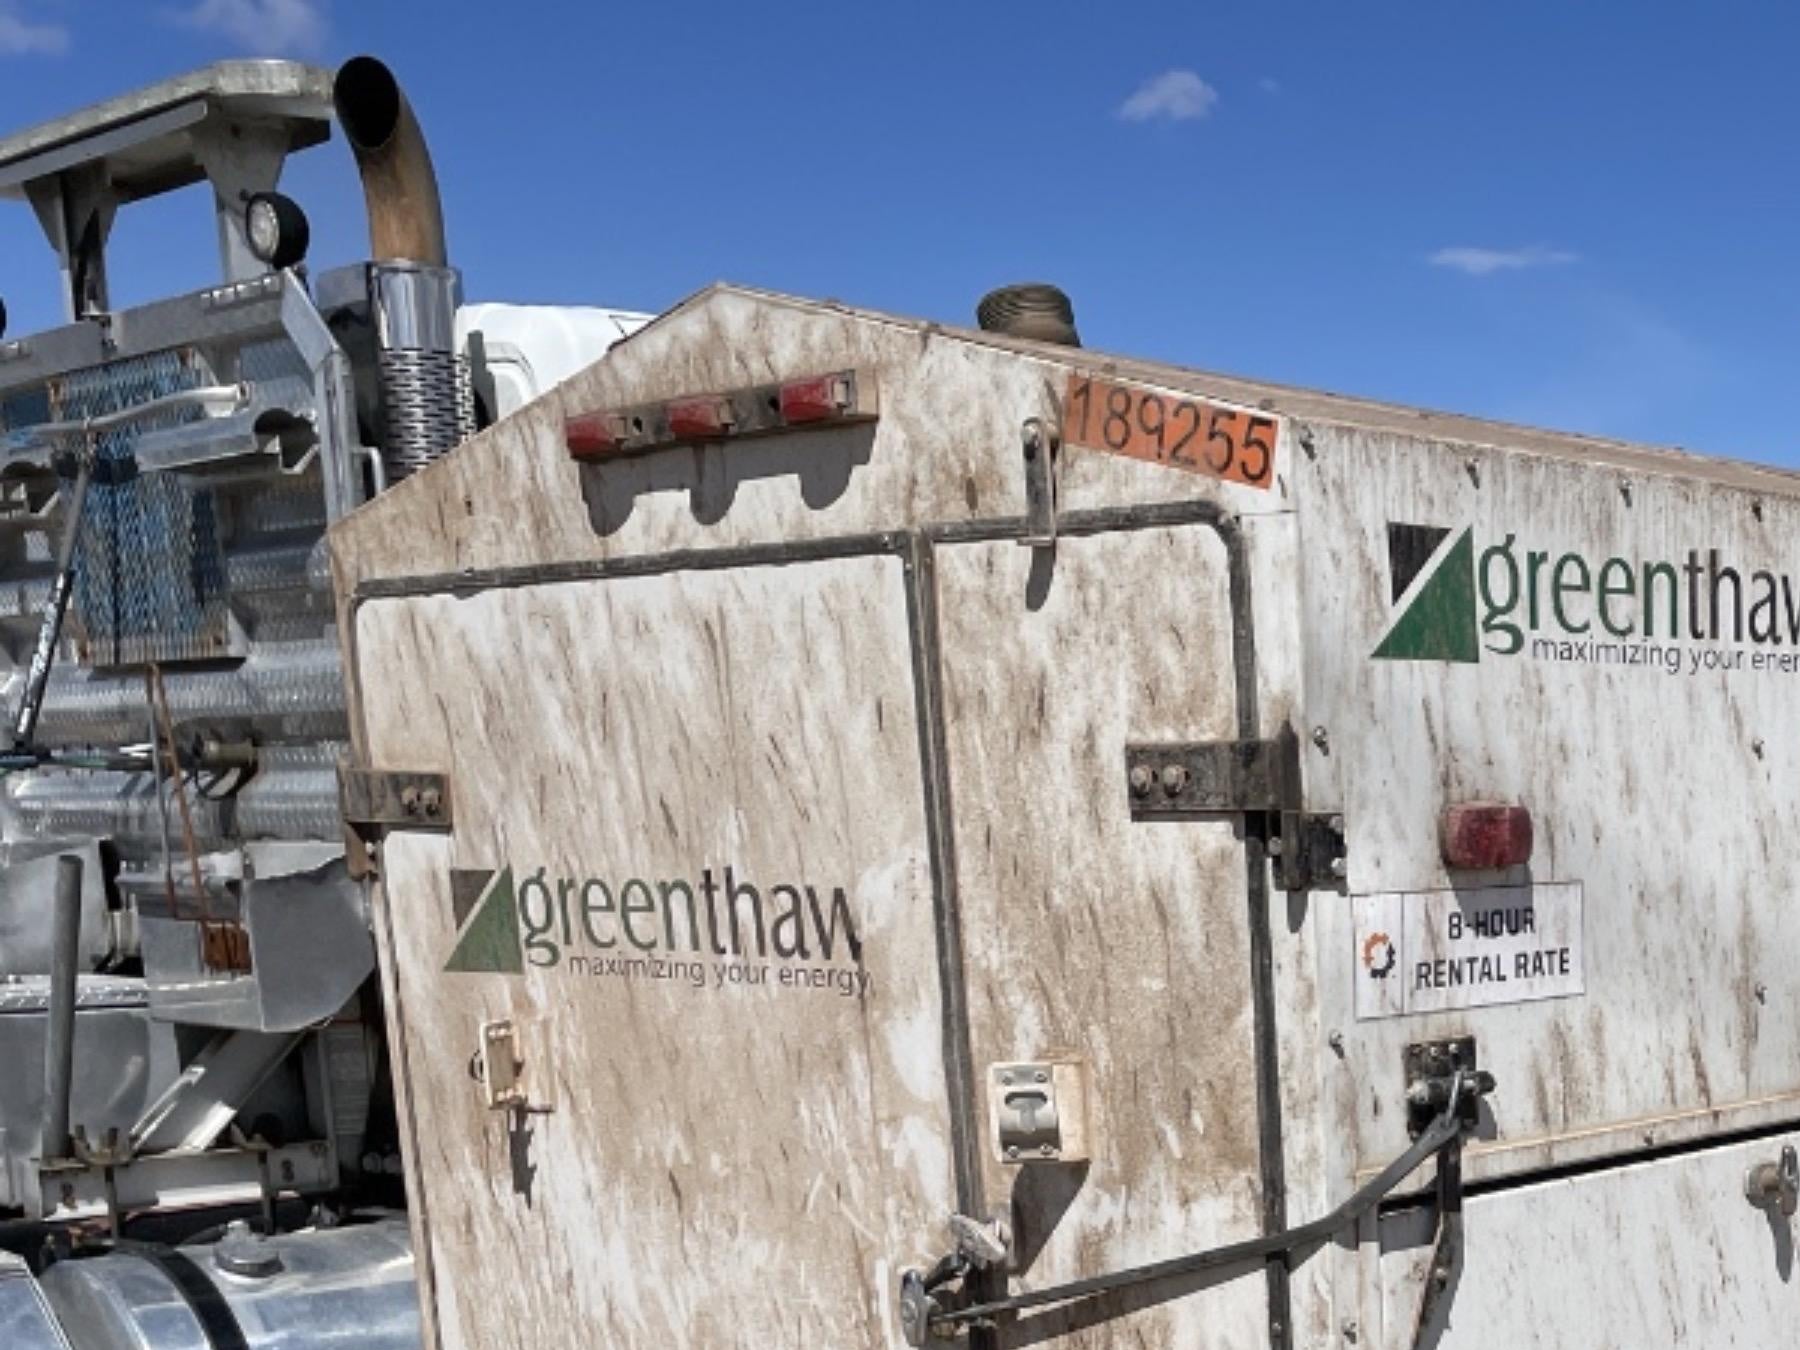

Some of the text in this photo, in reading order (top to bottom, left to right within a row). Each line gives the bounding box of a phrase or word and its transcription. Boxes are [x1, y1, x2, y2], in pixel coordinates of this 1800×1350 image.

[1073, 371, 1270, 482] 189255
[1531, 635, 1681, 675] maximizing
[1688, 647, 1743, 676] your
[518, 866, 863, 968] greenthaw
[1447, 906, 1536, 940] 8-HOUR
[568, 951, 874, 997] maximizing your energy
[1415, 947, 1571, 990] RENTAL RATE
